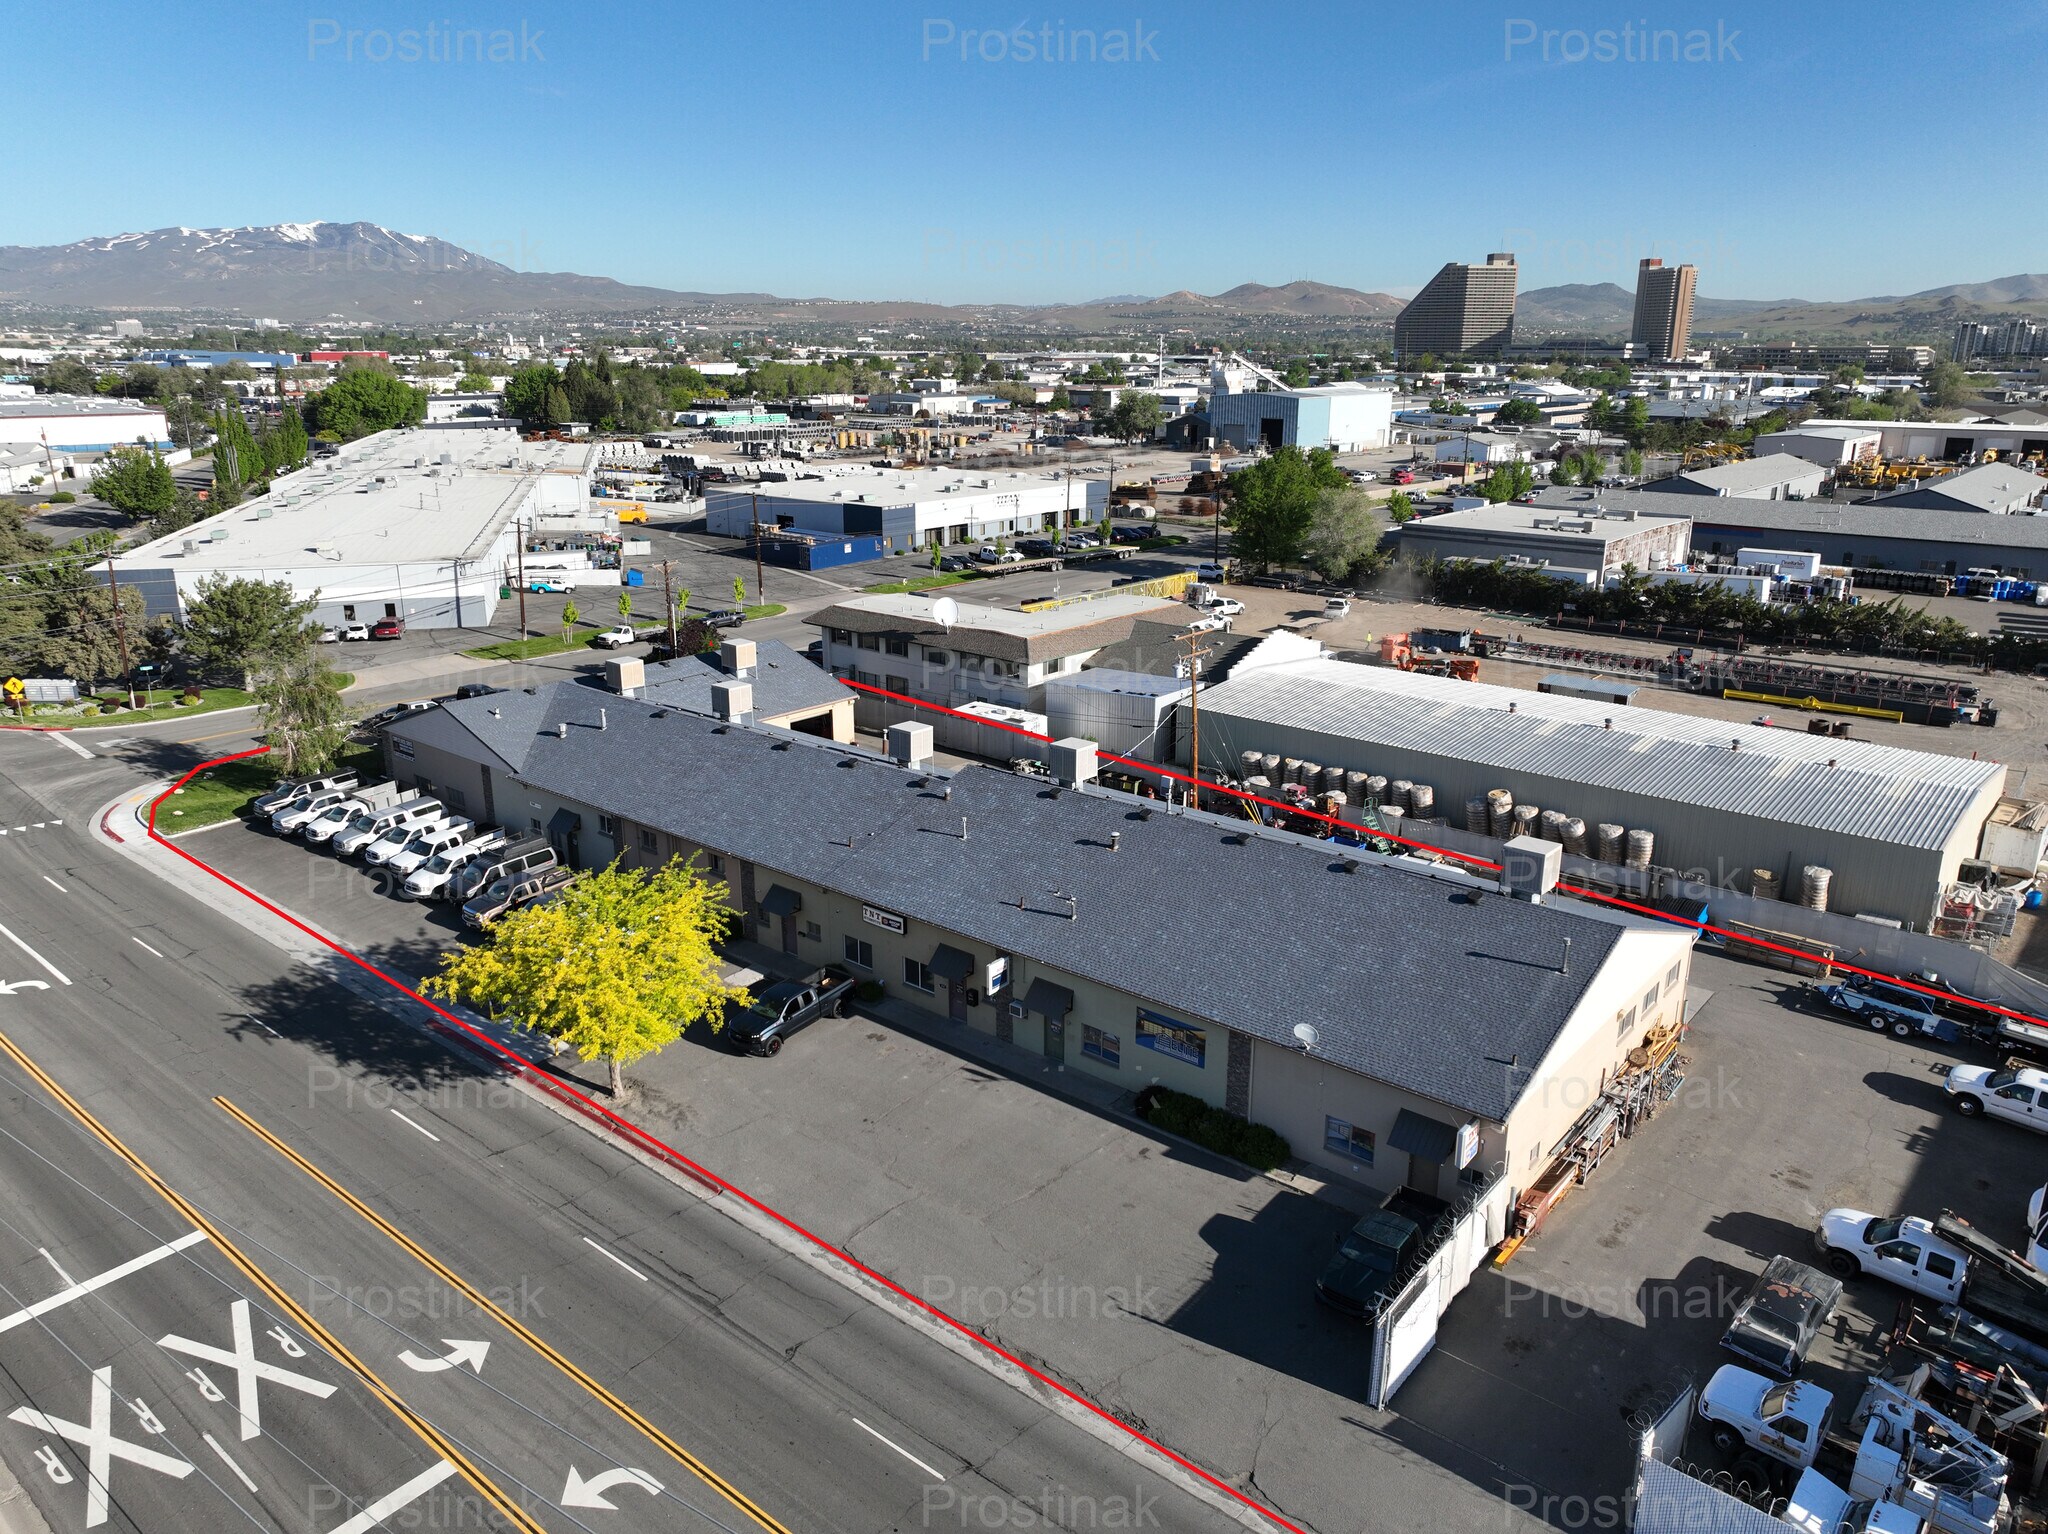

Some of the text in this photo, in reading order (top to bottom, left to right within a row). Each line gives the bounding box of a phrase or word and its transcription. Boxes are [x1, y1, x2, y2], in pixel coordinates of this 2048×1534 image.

[863, 907, 881, 920] TNT
[186, 1368, 226, 1402] R
[266, 1325, 307, 1358] R
[34, 1445, 73, 1484] R
[129, 1397, 166, 1434] R
